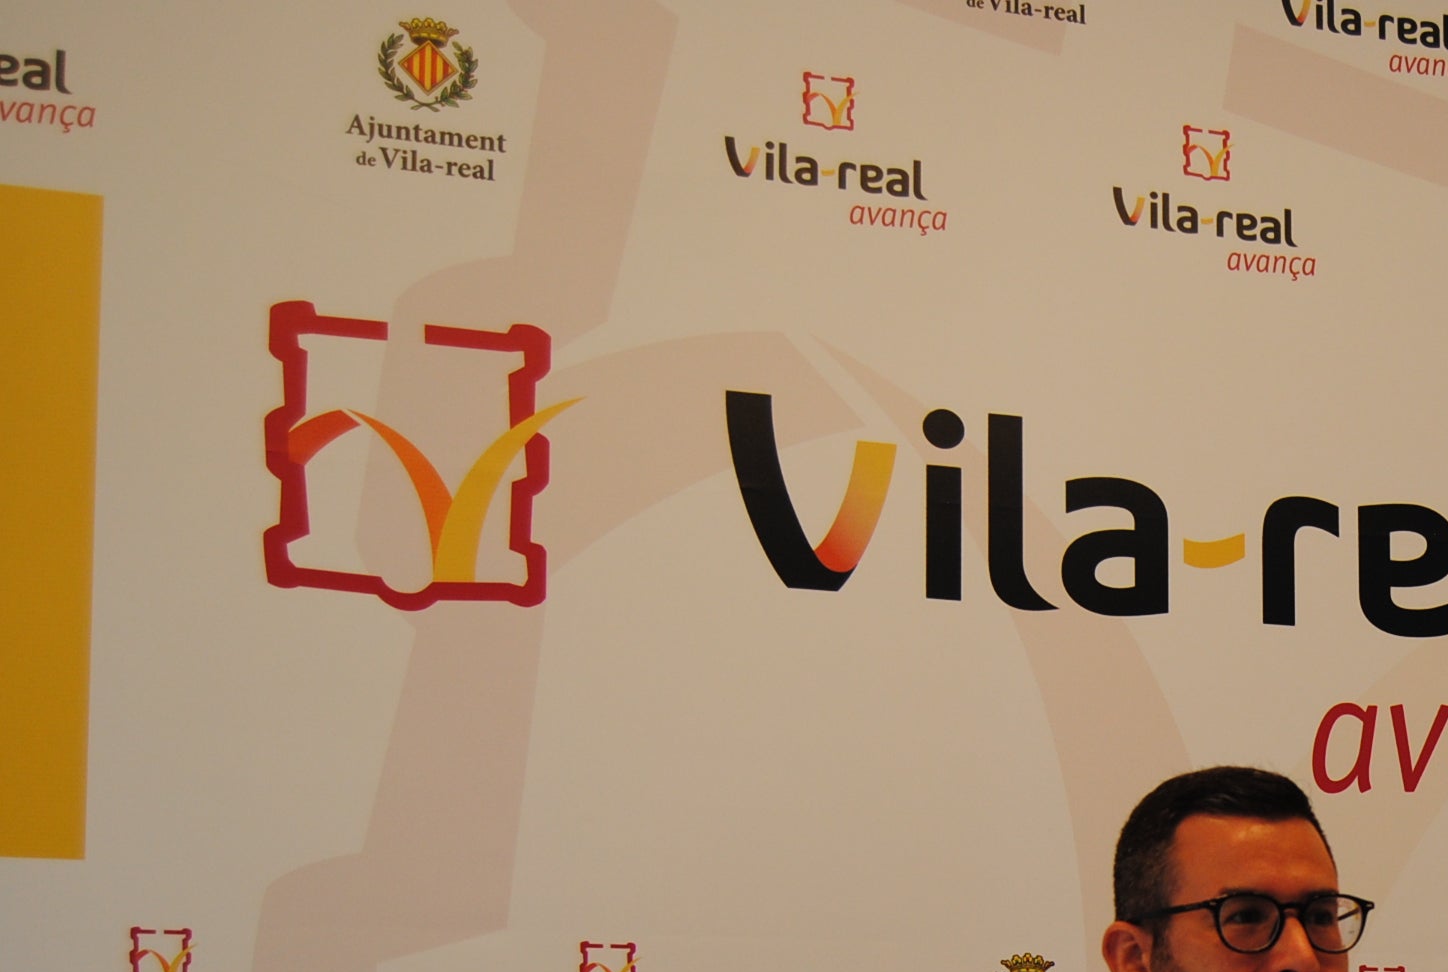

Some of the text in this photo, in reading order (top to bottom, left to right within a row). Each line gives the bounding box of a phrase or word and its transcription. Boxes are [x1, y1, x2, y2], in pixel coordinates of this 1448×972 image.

[991, 0, 1085, 24] Vila-real
[345, 114, 506, 154] Ajuntament
[356, 146, 496, 182] de Vila-real
[724, 136, 927, 201] Vila-real
[850, 205, 947, 236] avança
[1113, 186, 1298, 248] Vila-real
[1226, 250, 1316, 282] avança
